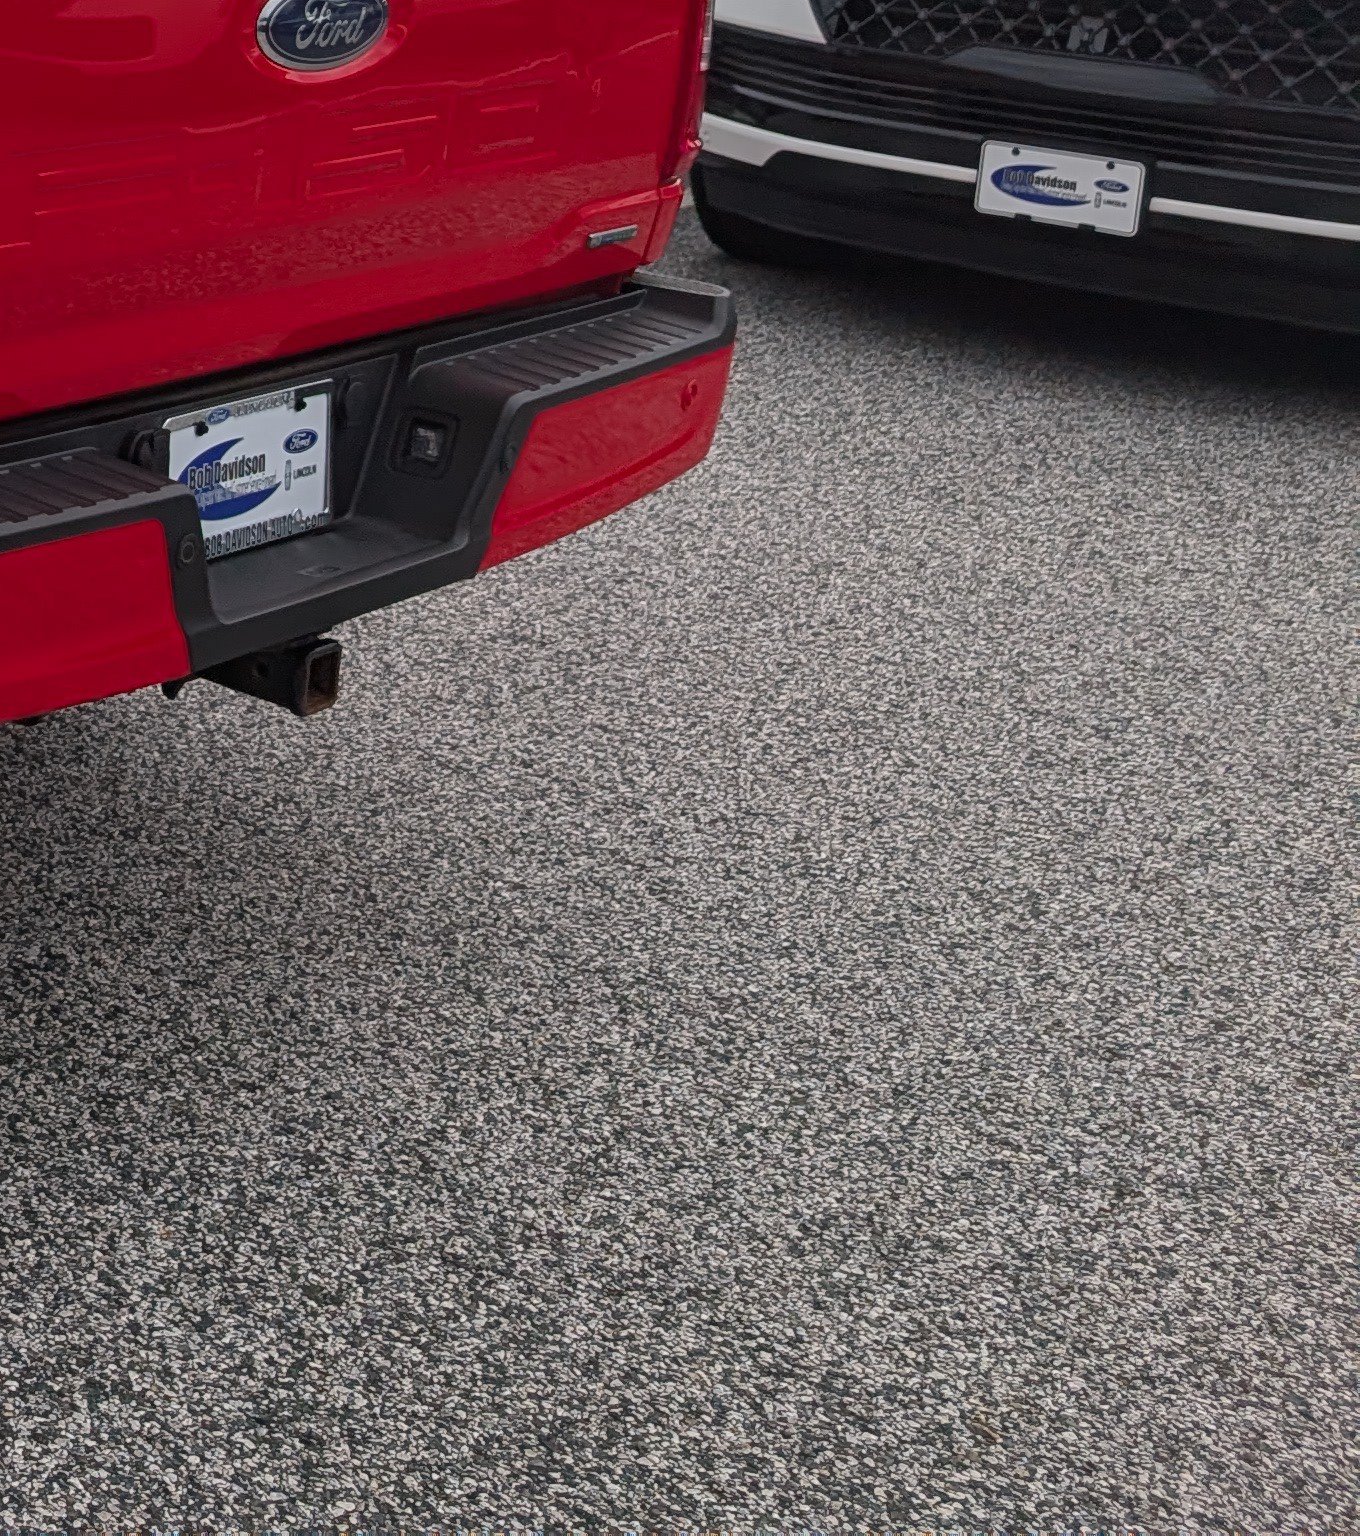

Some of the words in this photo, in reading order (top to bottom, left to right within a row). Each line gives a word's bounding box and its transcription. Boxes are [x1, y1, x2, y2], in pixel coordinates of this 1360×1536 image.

[1026, 170, 1078, 192] Davidson
[188, 463, 213, 490] Bob
[213, 453, 266, 484] Davidson
[292, 464, 318, 480] LINCOLN
